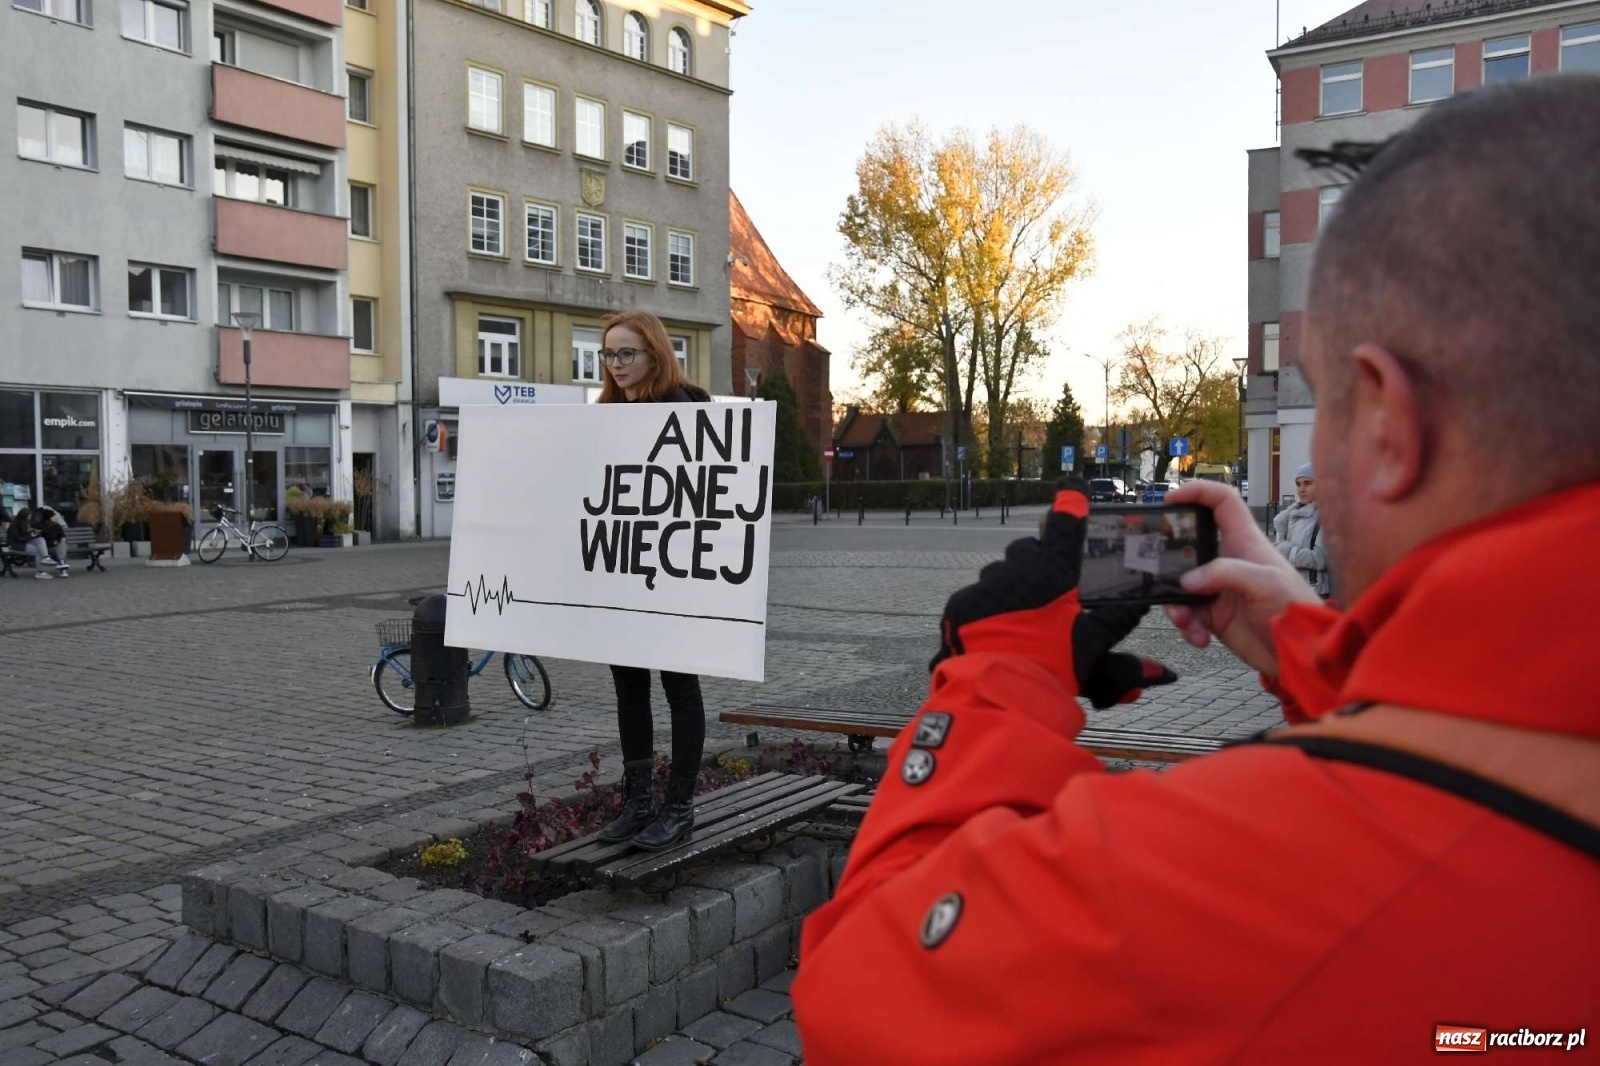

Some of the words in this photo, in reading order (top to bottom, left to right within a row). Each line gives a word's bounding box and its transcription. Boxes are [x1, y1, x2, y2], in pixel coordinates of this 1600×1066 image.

[513, 386, 535, 397] TEB
[43, 415, 96, 428] empik.com
[199, 410, 279, 431] gelatopiu
[647, 407, 753, 463] ANI
[1064, 447, 1072, 458] P
[1098, 446, 1106, 457] P
[583, 464, 769, 522] JEDNEJ
[580, 518, 756, 591] WIĘCEJ
